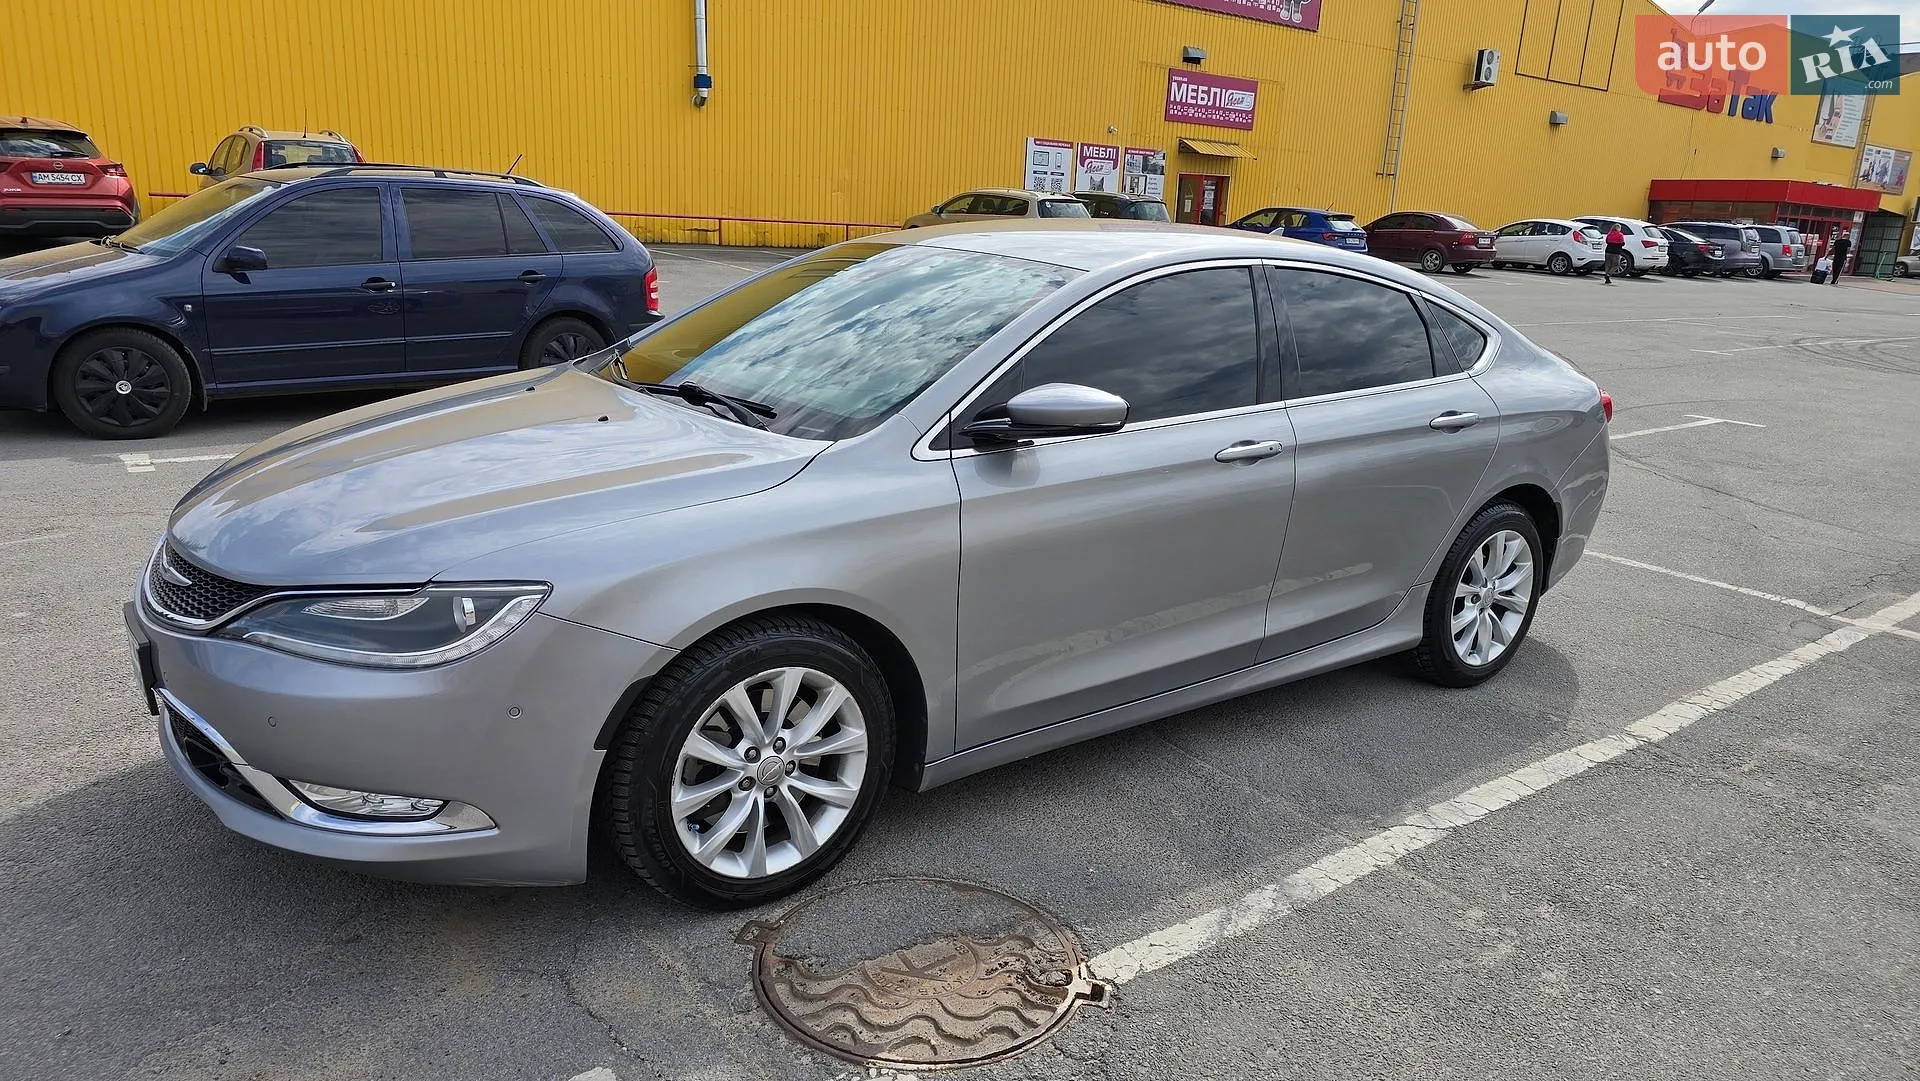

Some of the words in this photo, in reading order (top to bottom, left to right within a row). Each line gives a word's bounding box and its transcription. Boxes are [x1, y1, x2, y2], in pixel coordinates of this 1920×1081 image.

[1170, 81, 1226, 108] МЕБЛІ
[1083, 146, 1117, 160] МЕБЛІ
[51, 174, 70, 182] 5454
